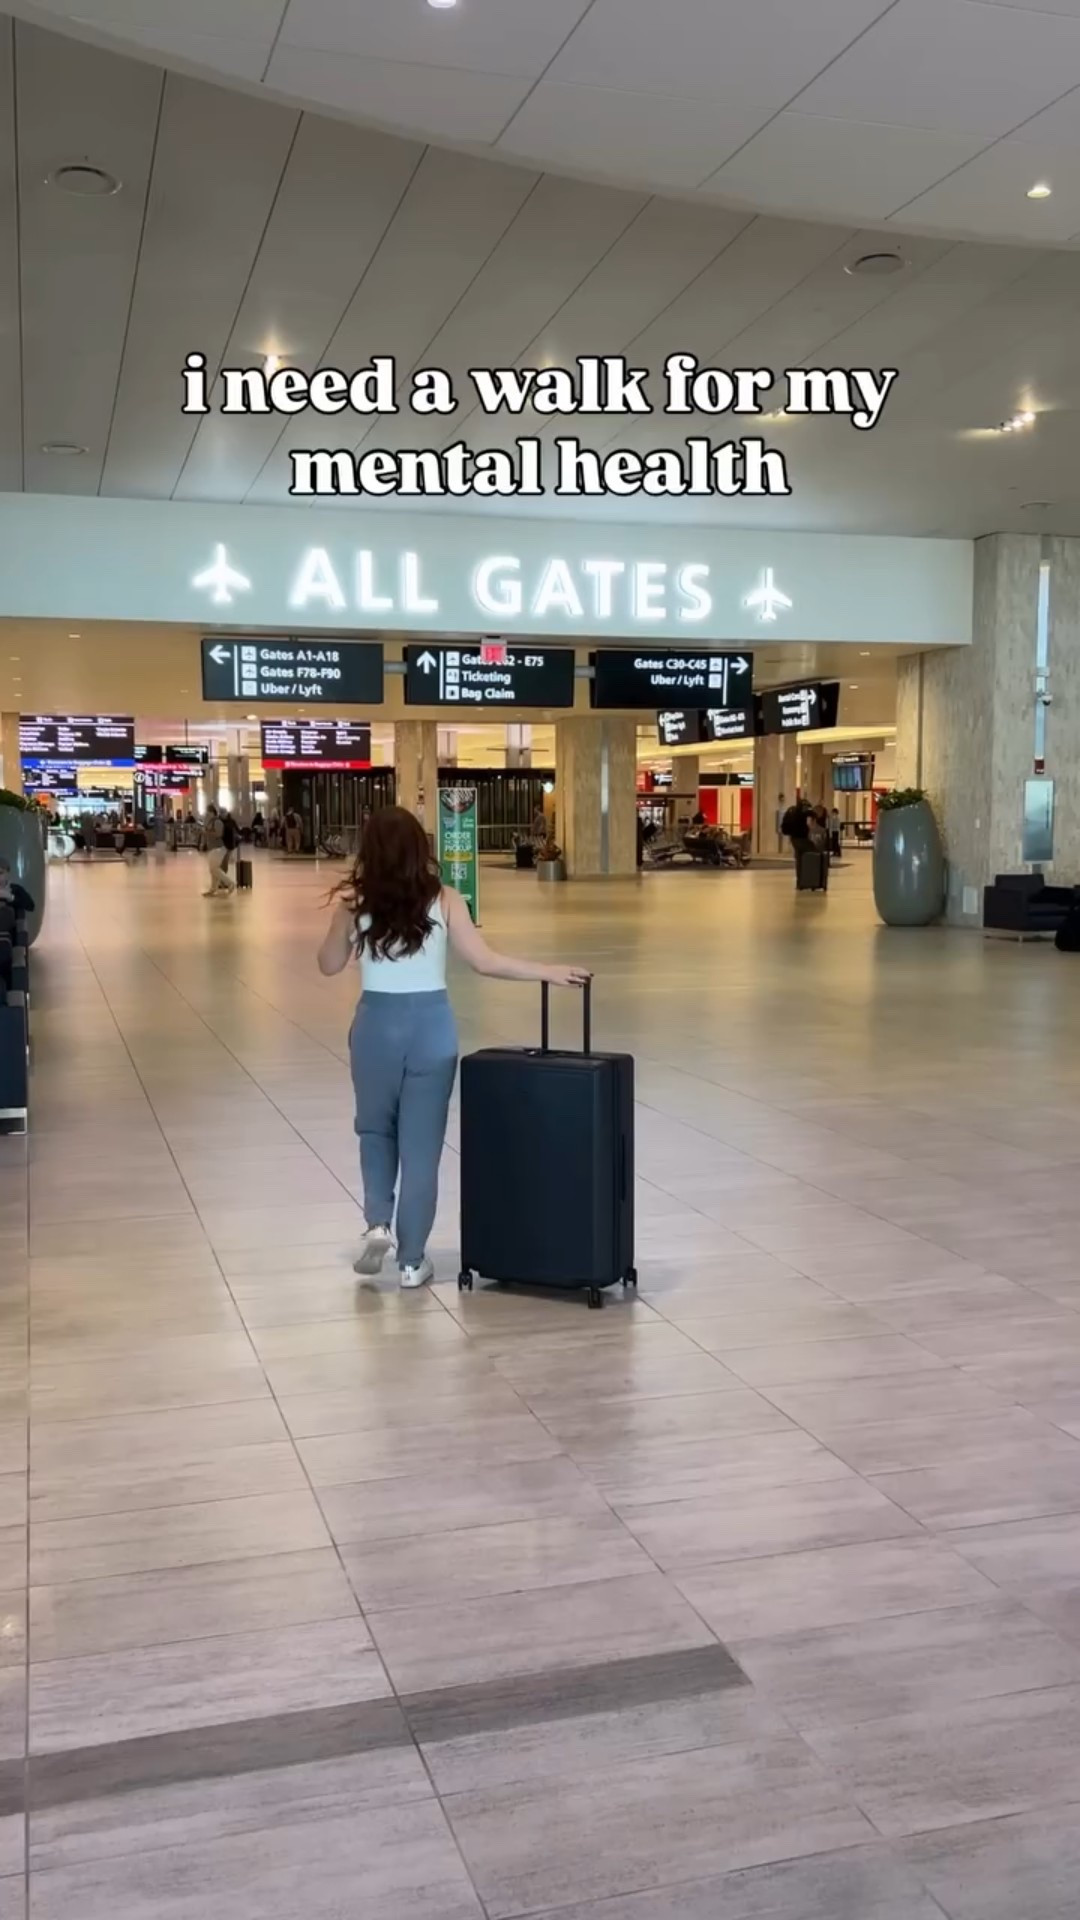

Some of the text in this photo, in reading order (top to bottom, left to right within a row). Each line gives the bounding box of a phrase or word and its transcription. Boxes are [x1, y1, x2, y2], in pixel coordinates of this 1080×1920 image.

[289, 547, 713, 621] ALL GATES
[260, 648, 340, 663] Gates A1-A18
[524, 656, 544, 667] E75
[633, 658, 708, 671] Gates C30-C45
[260, 665, 342, 680] Gates F78-F90
[461, 670, 512, 685] Ticketing
[650, 674, 676, 686] Uber
[683, 674, 705, 688] Lyft
[260, 682, 323, 698] Uber / Lyft
[461, 687, 515, 702] Bag Claim
